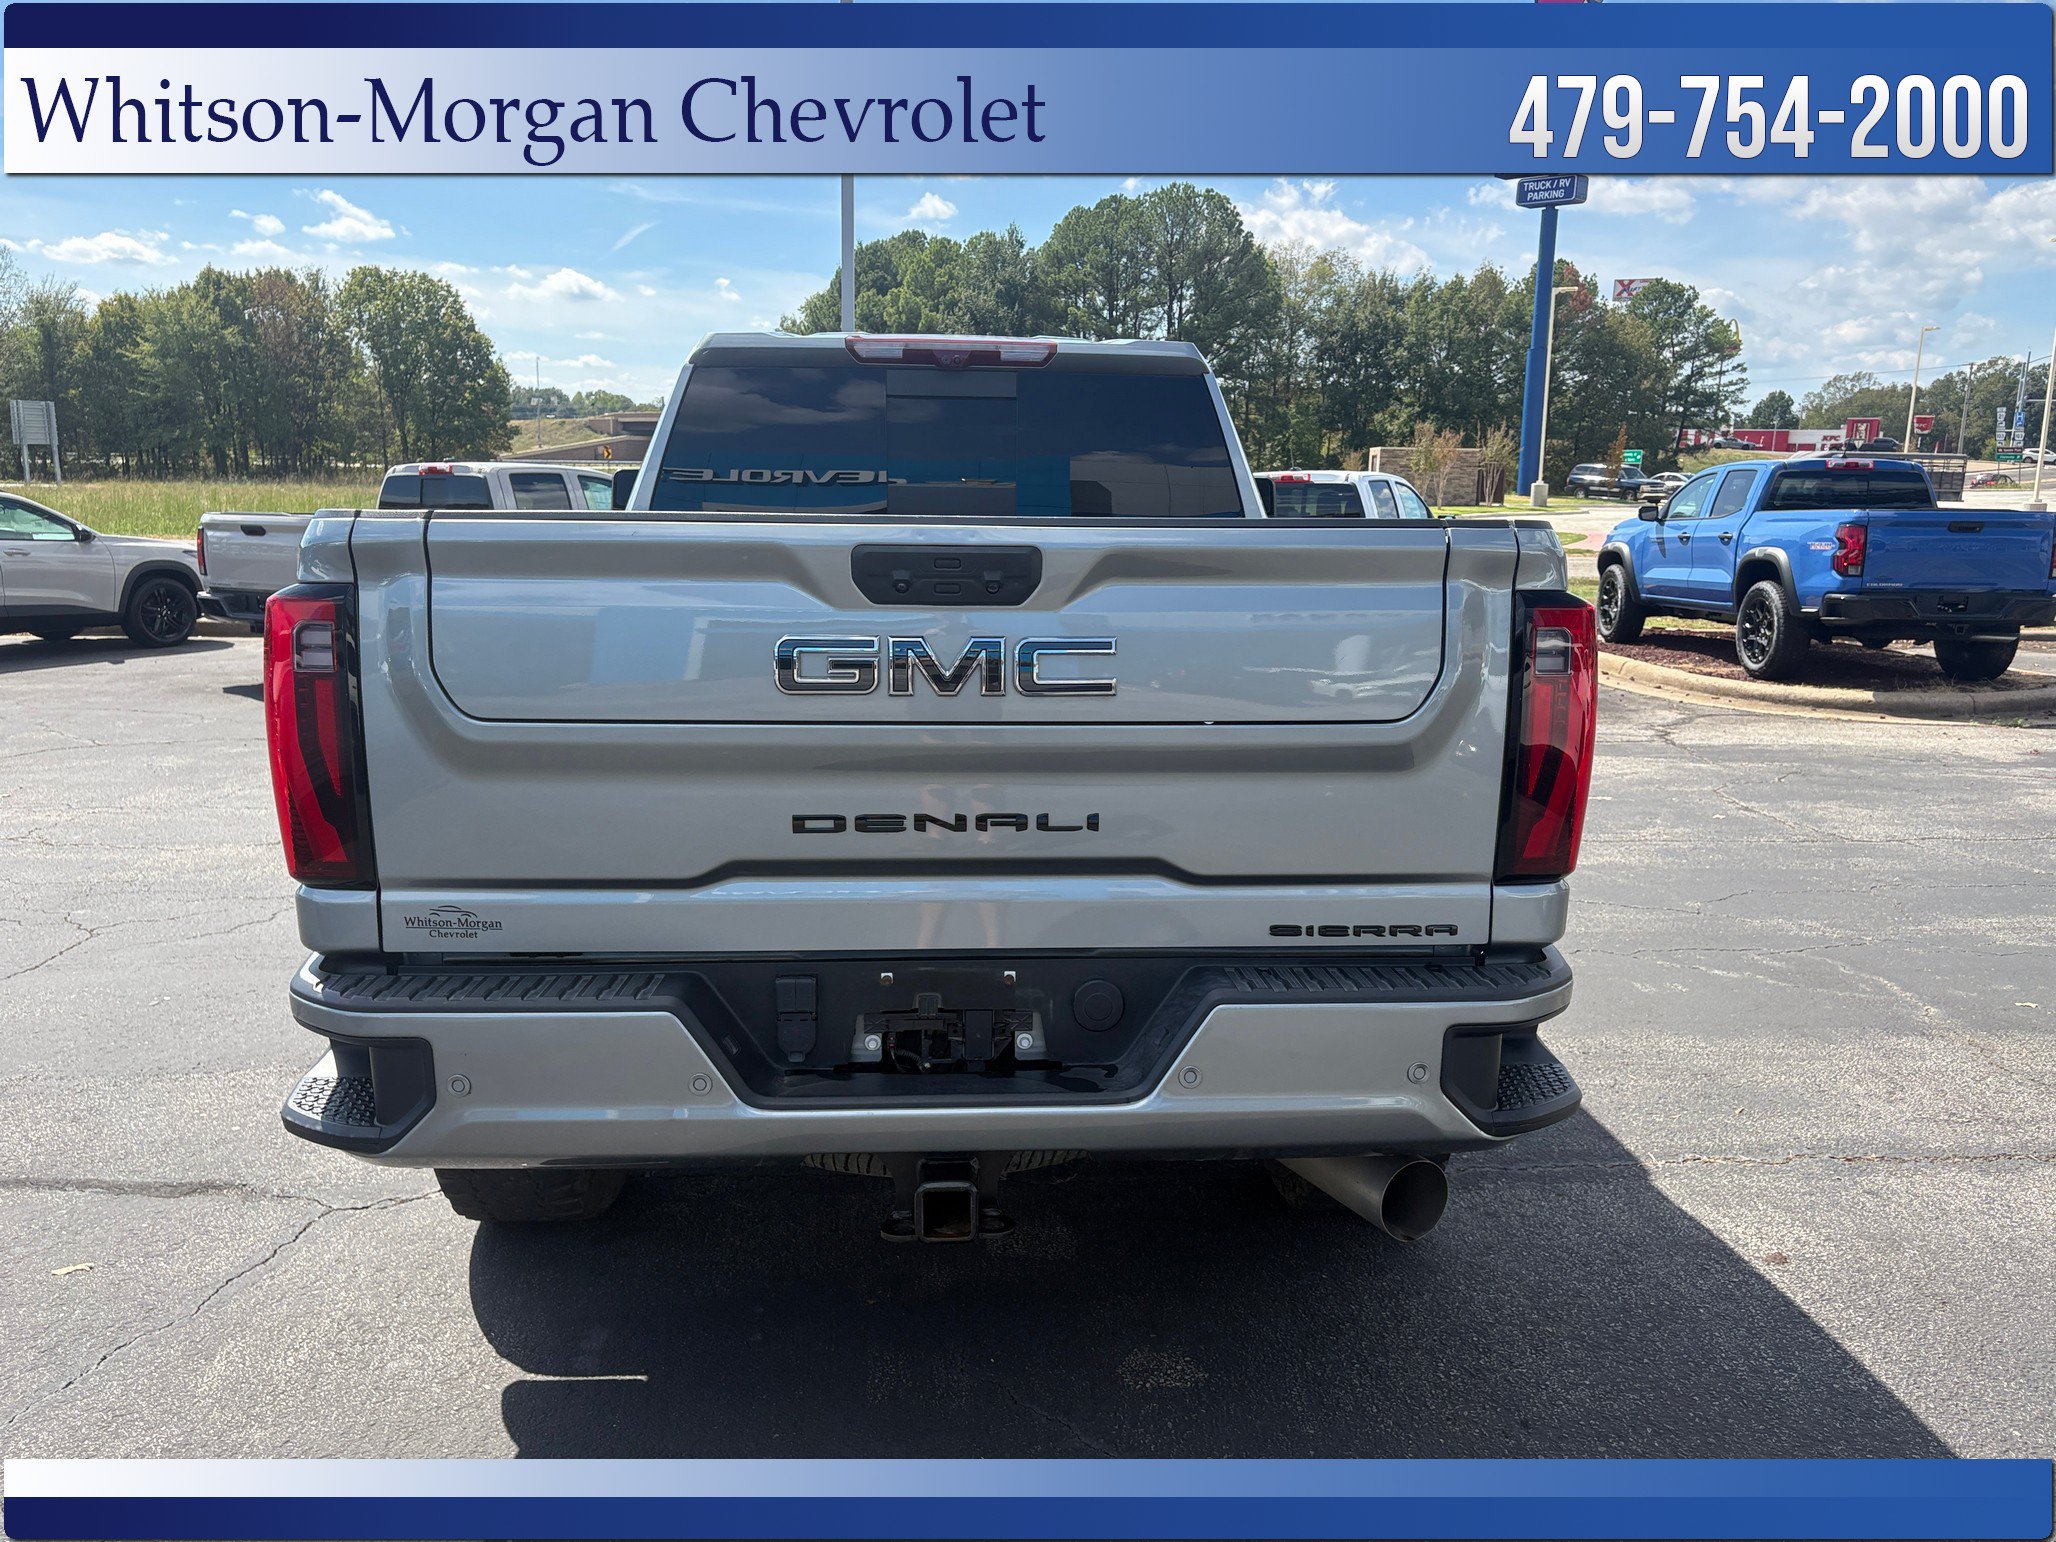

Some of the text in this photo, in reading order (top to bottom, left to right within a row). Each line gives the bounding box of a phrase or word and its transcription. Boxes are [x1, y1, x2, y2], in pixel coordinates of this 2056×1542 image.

[1523, 181, 1551, 191] TRUCK
[1559, 178, 1571, 188] RV
[1527, 190, 1565, 201] PARKING
[774, 634, 1118, 696] GMC
[792, 813, 1099, 834] DENALI
[404, 916, 502, 931] Whitson-Morgan
[429, 930, 478, 939] Chevrolet
[1269, 924, 1459, 938] SIERRA
